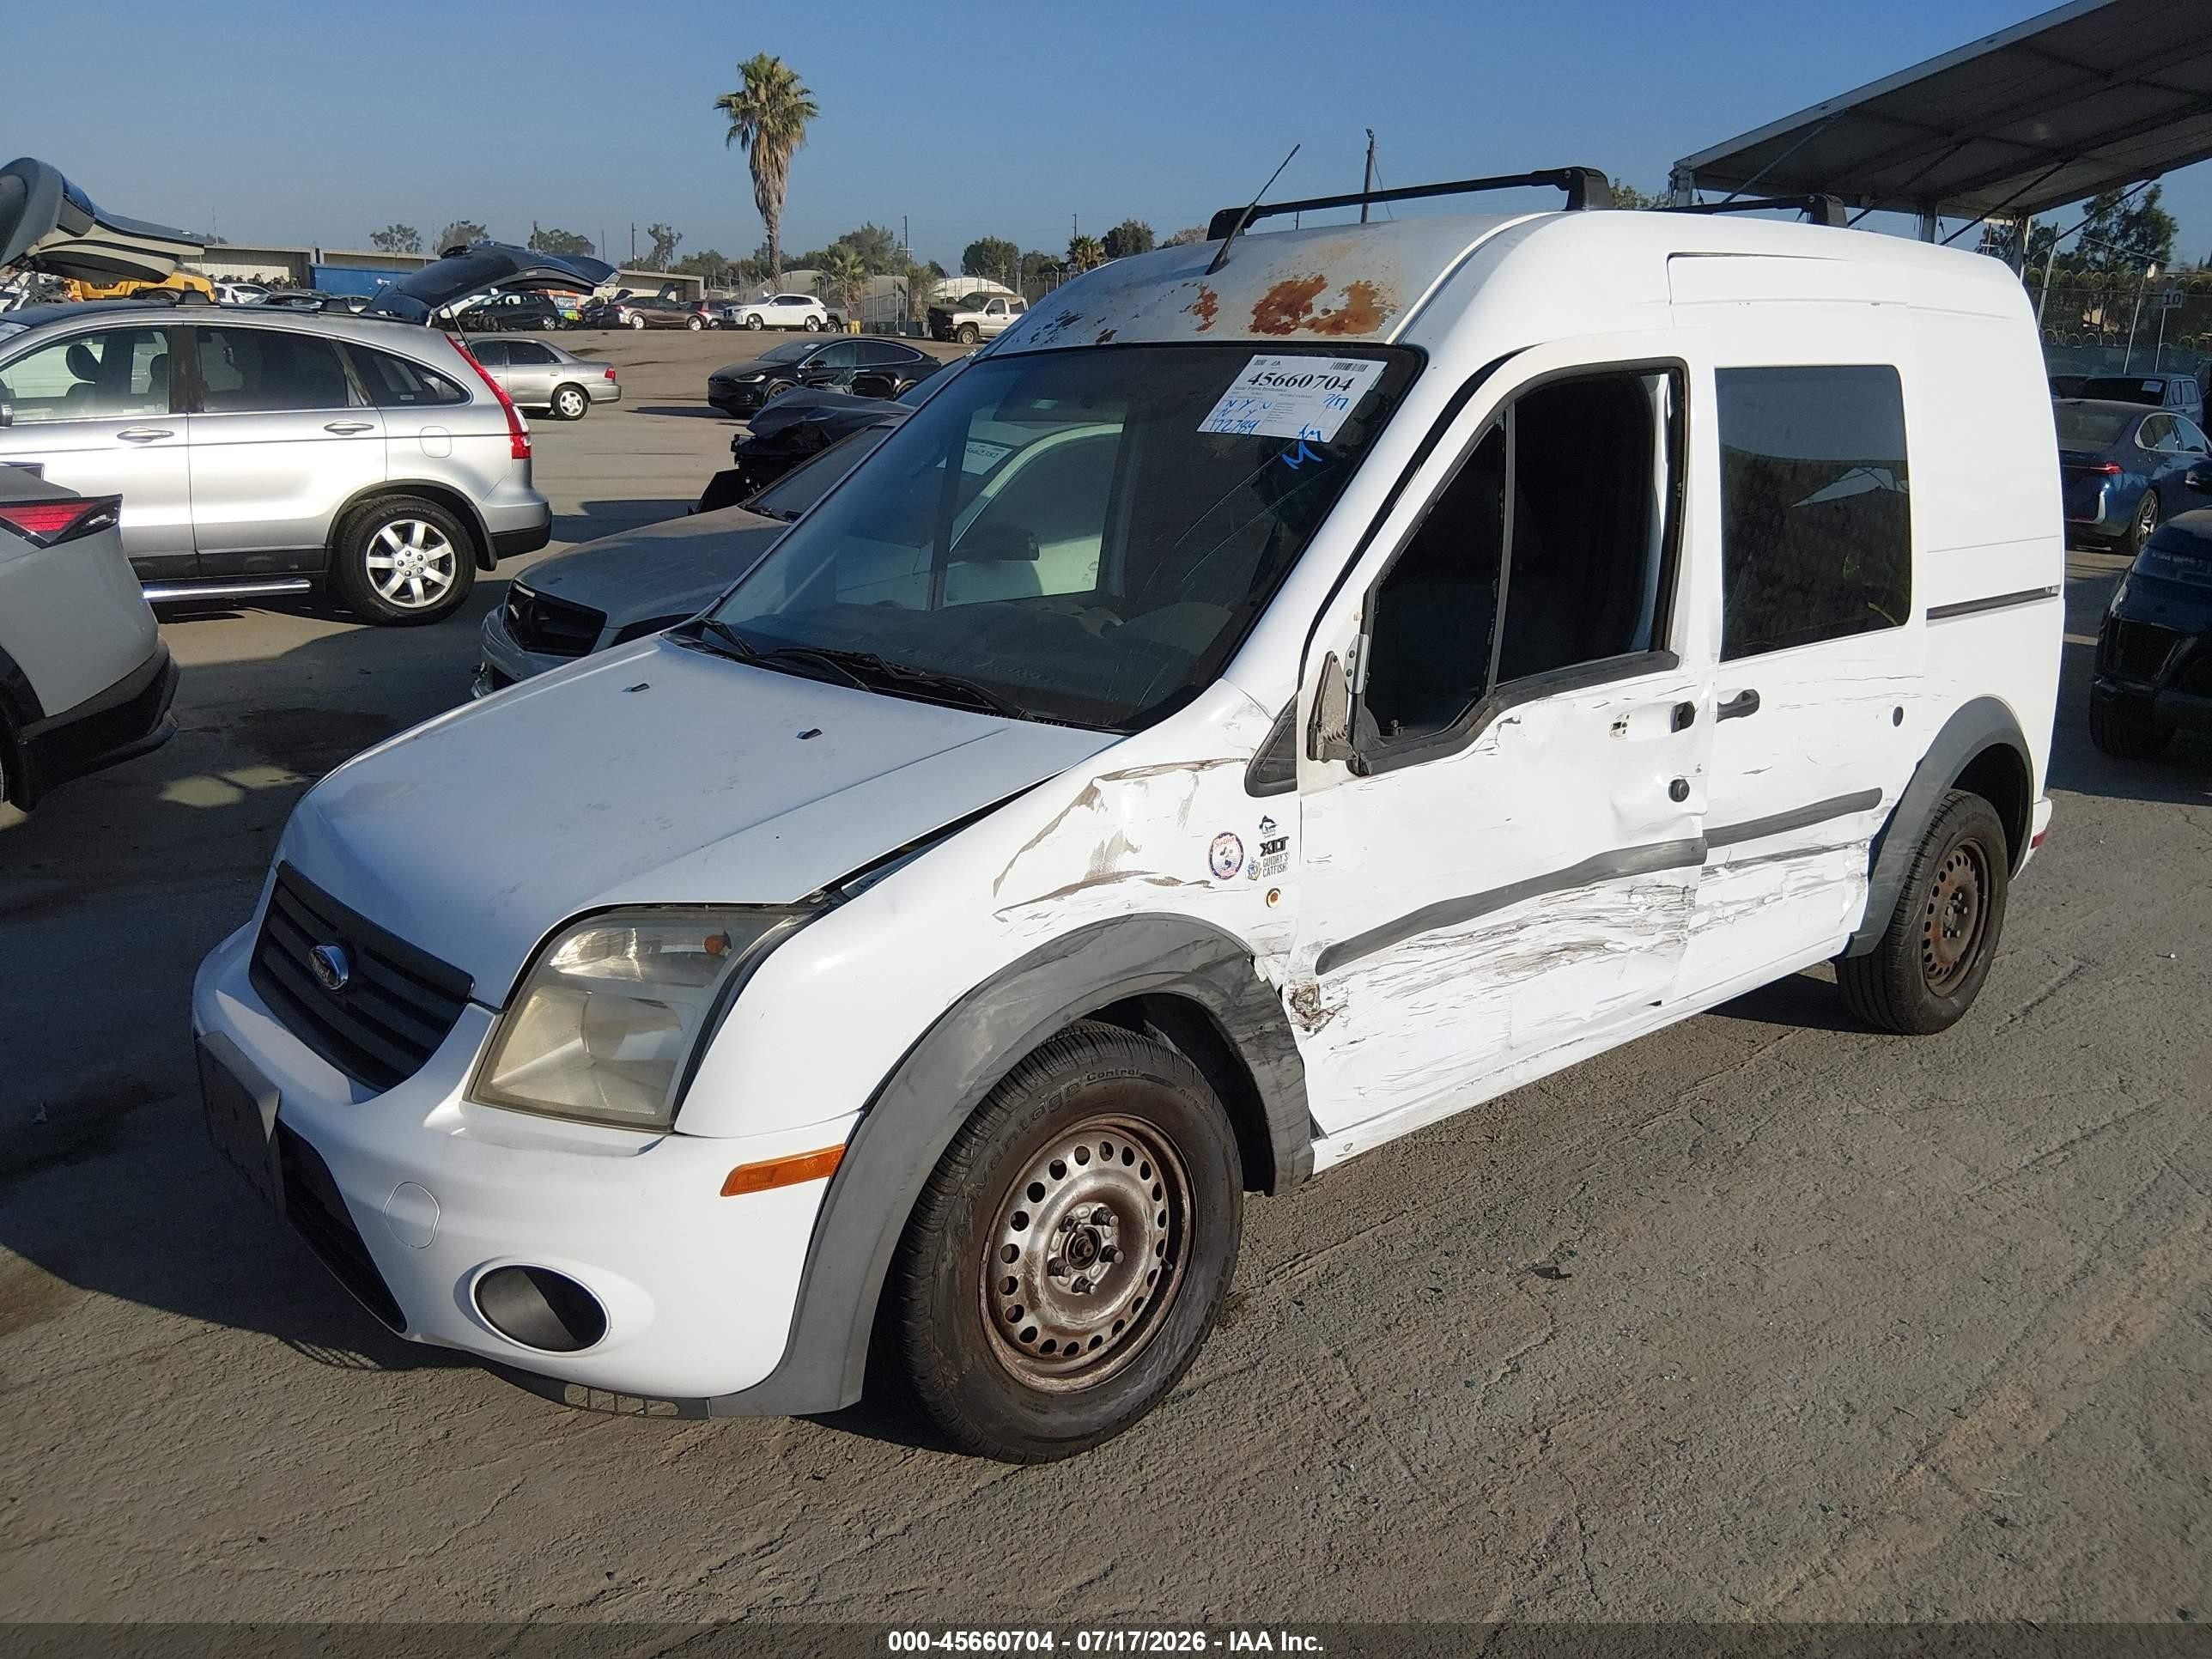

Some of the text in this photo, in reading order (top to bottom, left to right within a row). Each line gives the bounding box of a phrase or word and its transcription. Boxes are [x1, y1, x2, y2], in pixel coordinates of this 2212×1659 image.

[2164, 294, 2181, 305] 10
[1248, 371, 1355, 392] 45660704
[1260, 836, 1290, 857] XLT
[1085, 1068, 1140, 1082] Control
